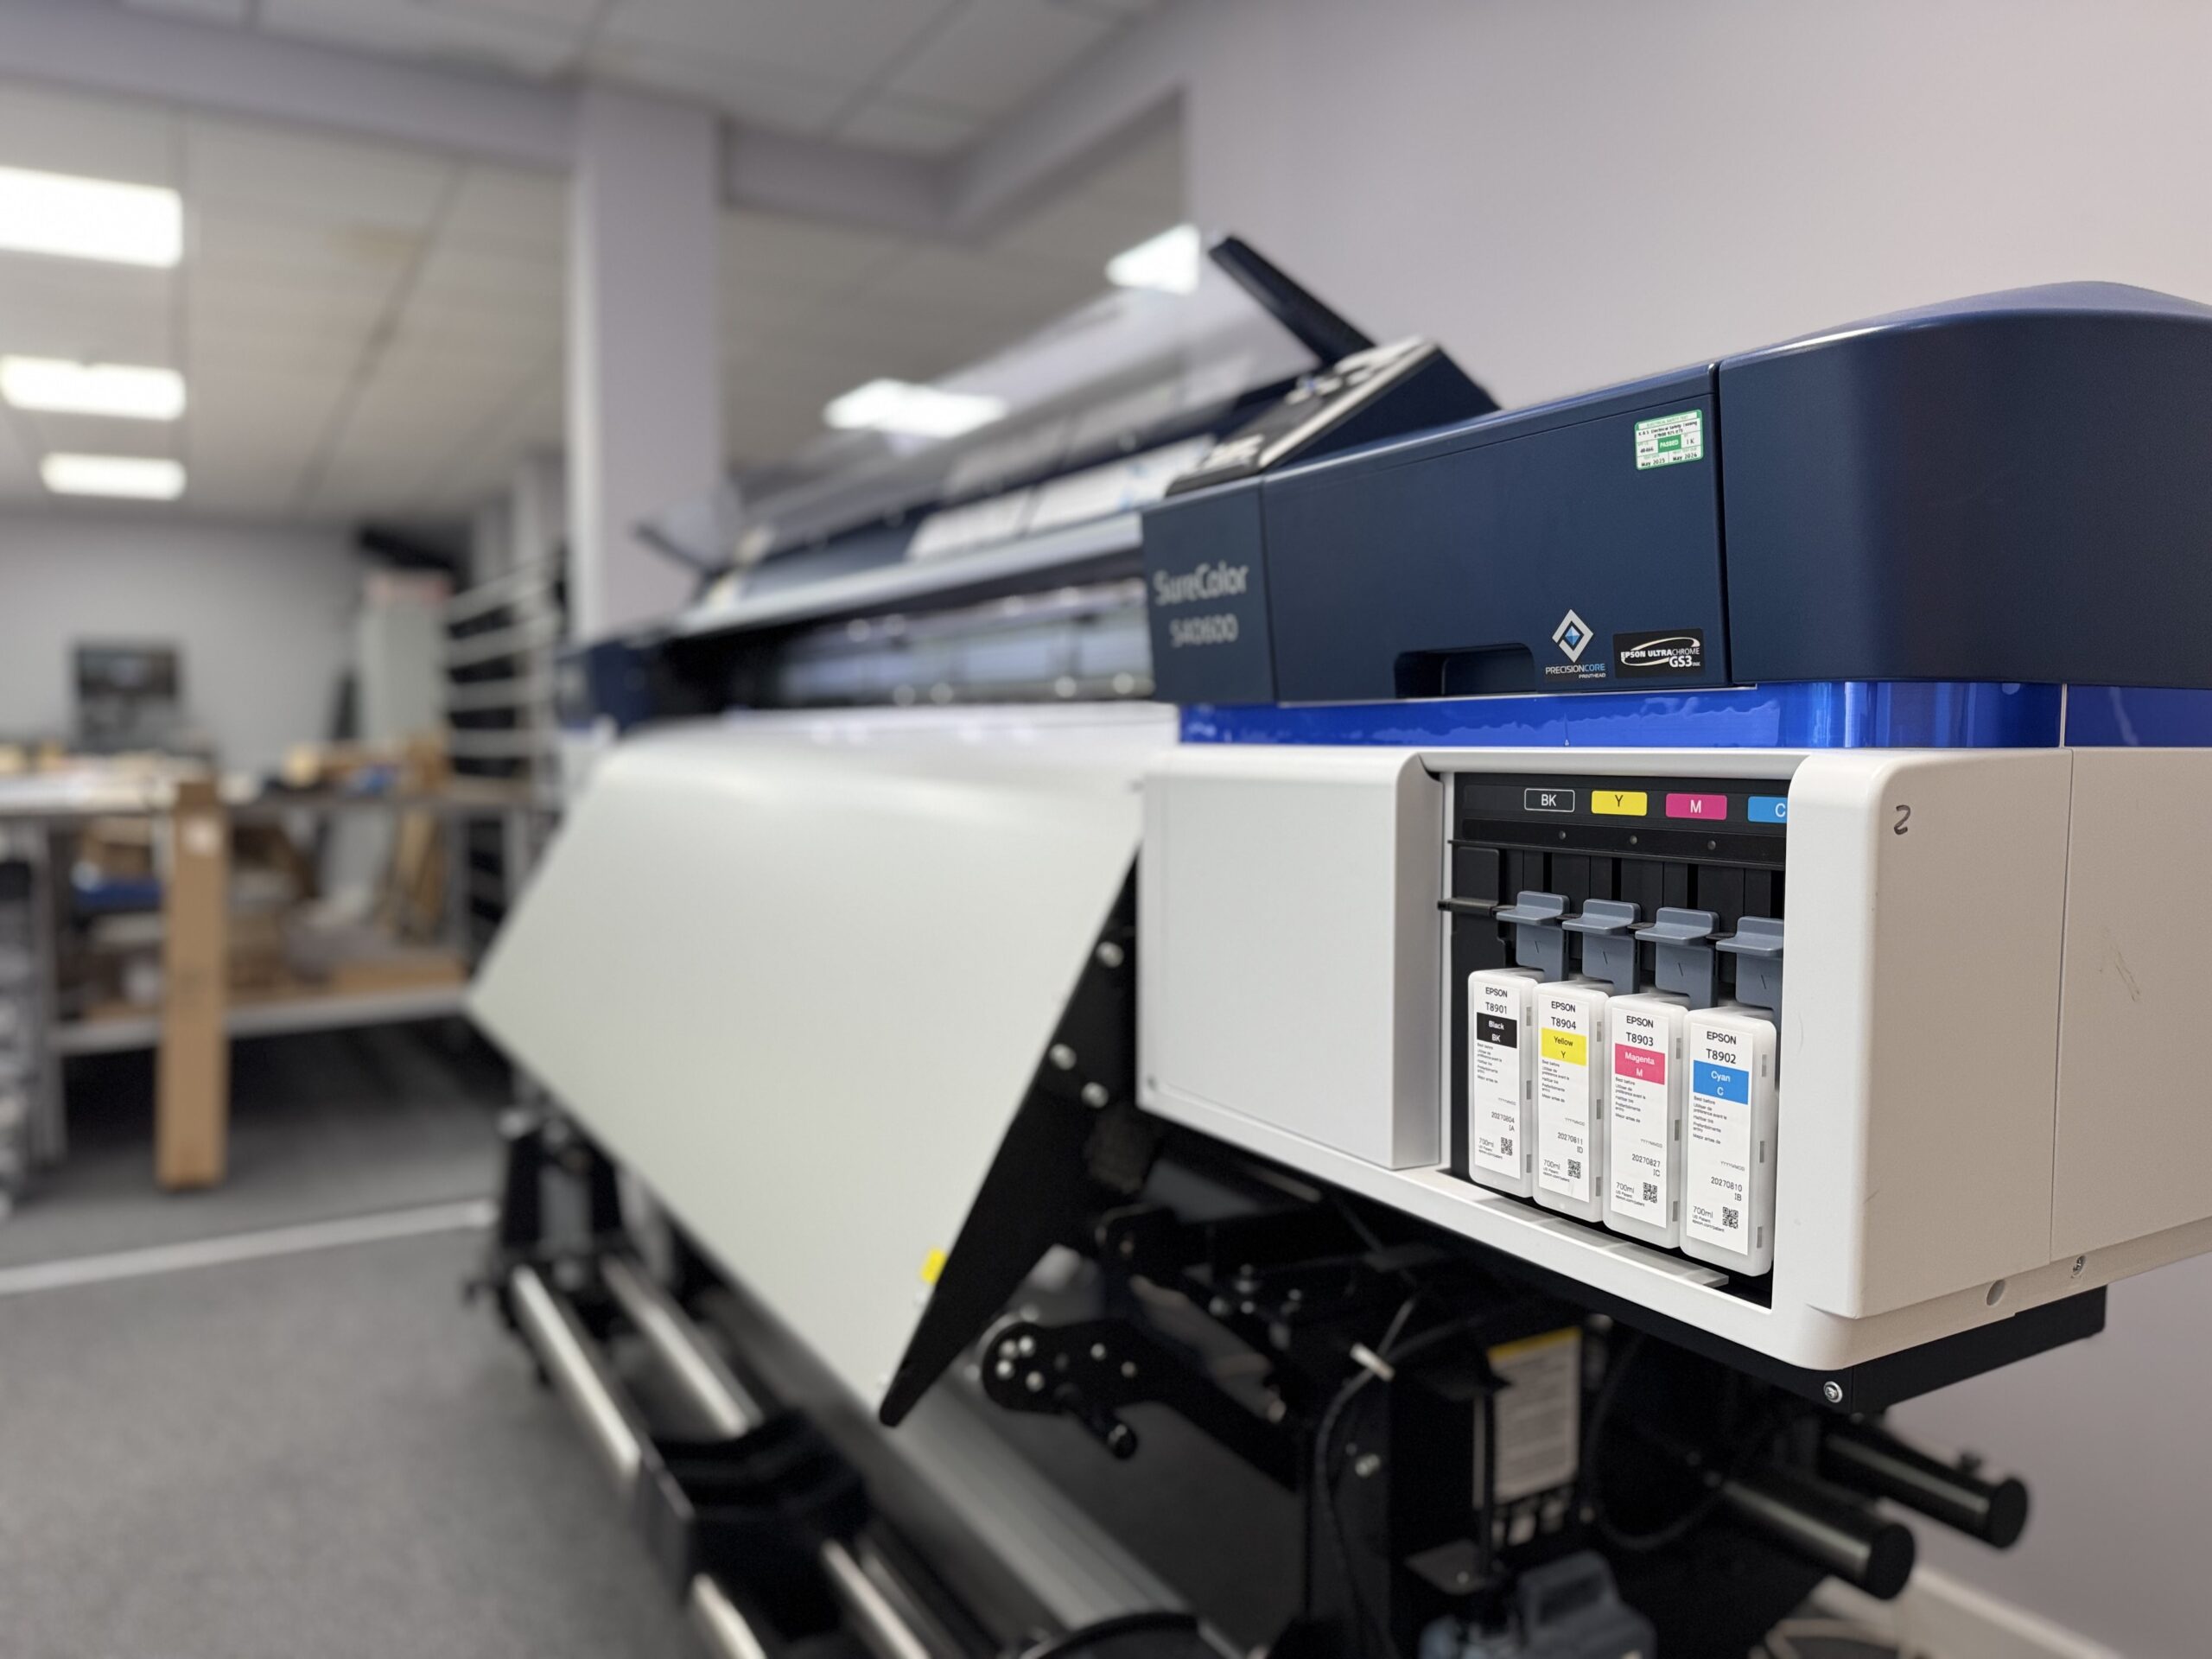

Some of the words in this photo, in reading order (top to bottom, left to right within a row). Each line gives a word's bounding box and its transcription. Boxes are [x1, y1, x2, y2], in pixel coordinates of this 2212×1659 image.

[1659, 439, 1679, 448] PASSED
[1153, 560, 1249, 606] SureColor
[1621, 650, 1646, 658] EPSON
[1648, 648, 1700, 657] ULTRACHROME
[1669, 655, 1693, 668] GS3
[1545, 664, 1605, 675] PRECISIONCORE
[1541, 793, 1557, 807] BK
[1615, 795, 1624, 807] Y
[1690, 799, 1701, 813] M
[1775, 803, 1786, 817] C
[1894, 804, 1910, 835] 2
[1485, 987, 1508, 997] EPSON
[1485, 1002, 1507, 1014] T8901
[1551, 1001, 1576, 1013] EPSON
[1489, 1020, 1504, 1030] Black
[1551, 1017, 1576, 1030] T8904
[1626, 1015, 1654, 1028] EPSON
[1491, 1033, 1501, 1042] BK
[1554, 1036, 1573, 1047] Yellow
[1626, 1032, 1654, 1046] T8903
[1707, 1031, 1737, 1045] EPSON
[1624, 1052, 1655, 1065] Magenta
[1706, 1048, 1737, 1065] T8902
[1637, 1068, 1643, 1077] M
[1711, 1071, 1731, 1082] Cyan
[1717, 1087, 1724, 1096] C
[1557, 1132, 1583, 1145] 20270811
[1632, 1154, 1661, 1167] 20270827
[1617, 1182, 1634, 1194] 700ml
[1711, 1176, 1743, 1192] 20270810
[1734, 1192, 1742, 1201] IB
[1694, 1206, 1713, 1218] 700ml
